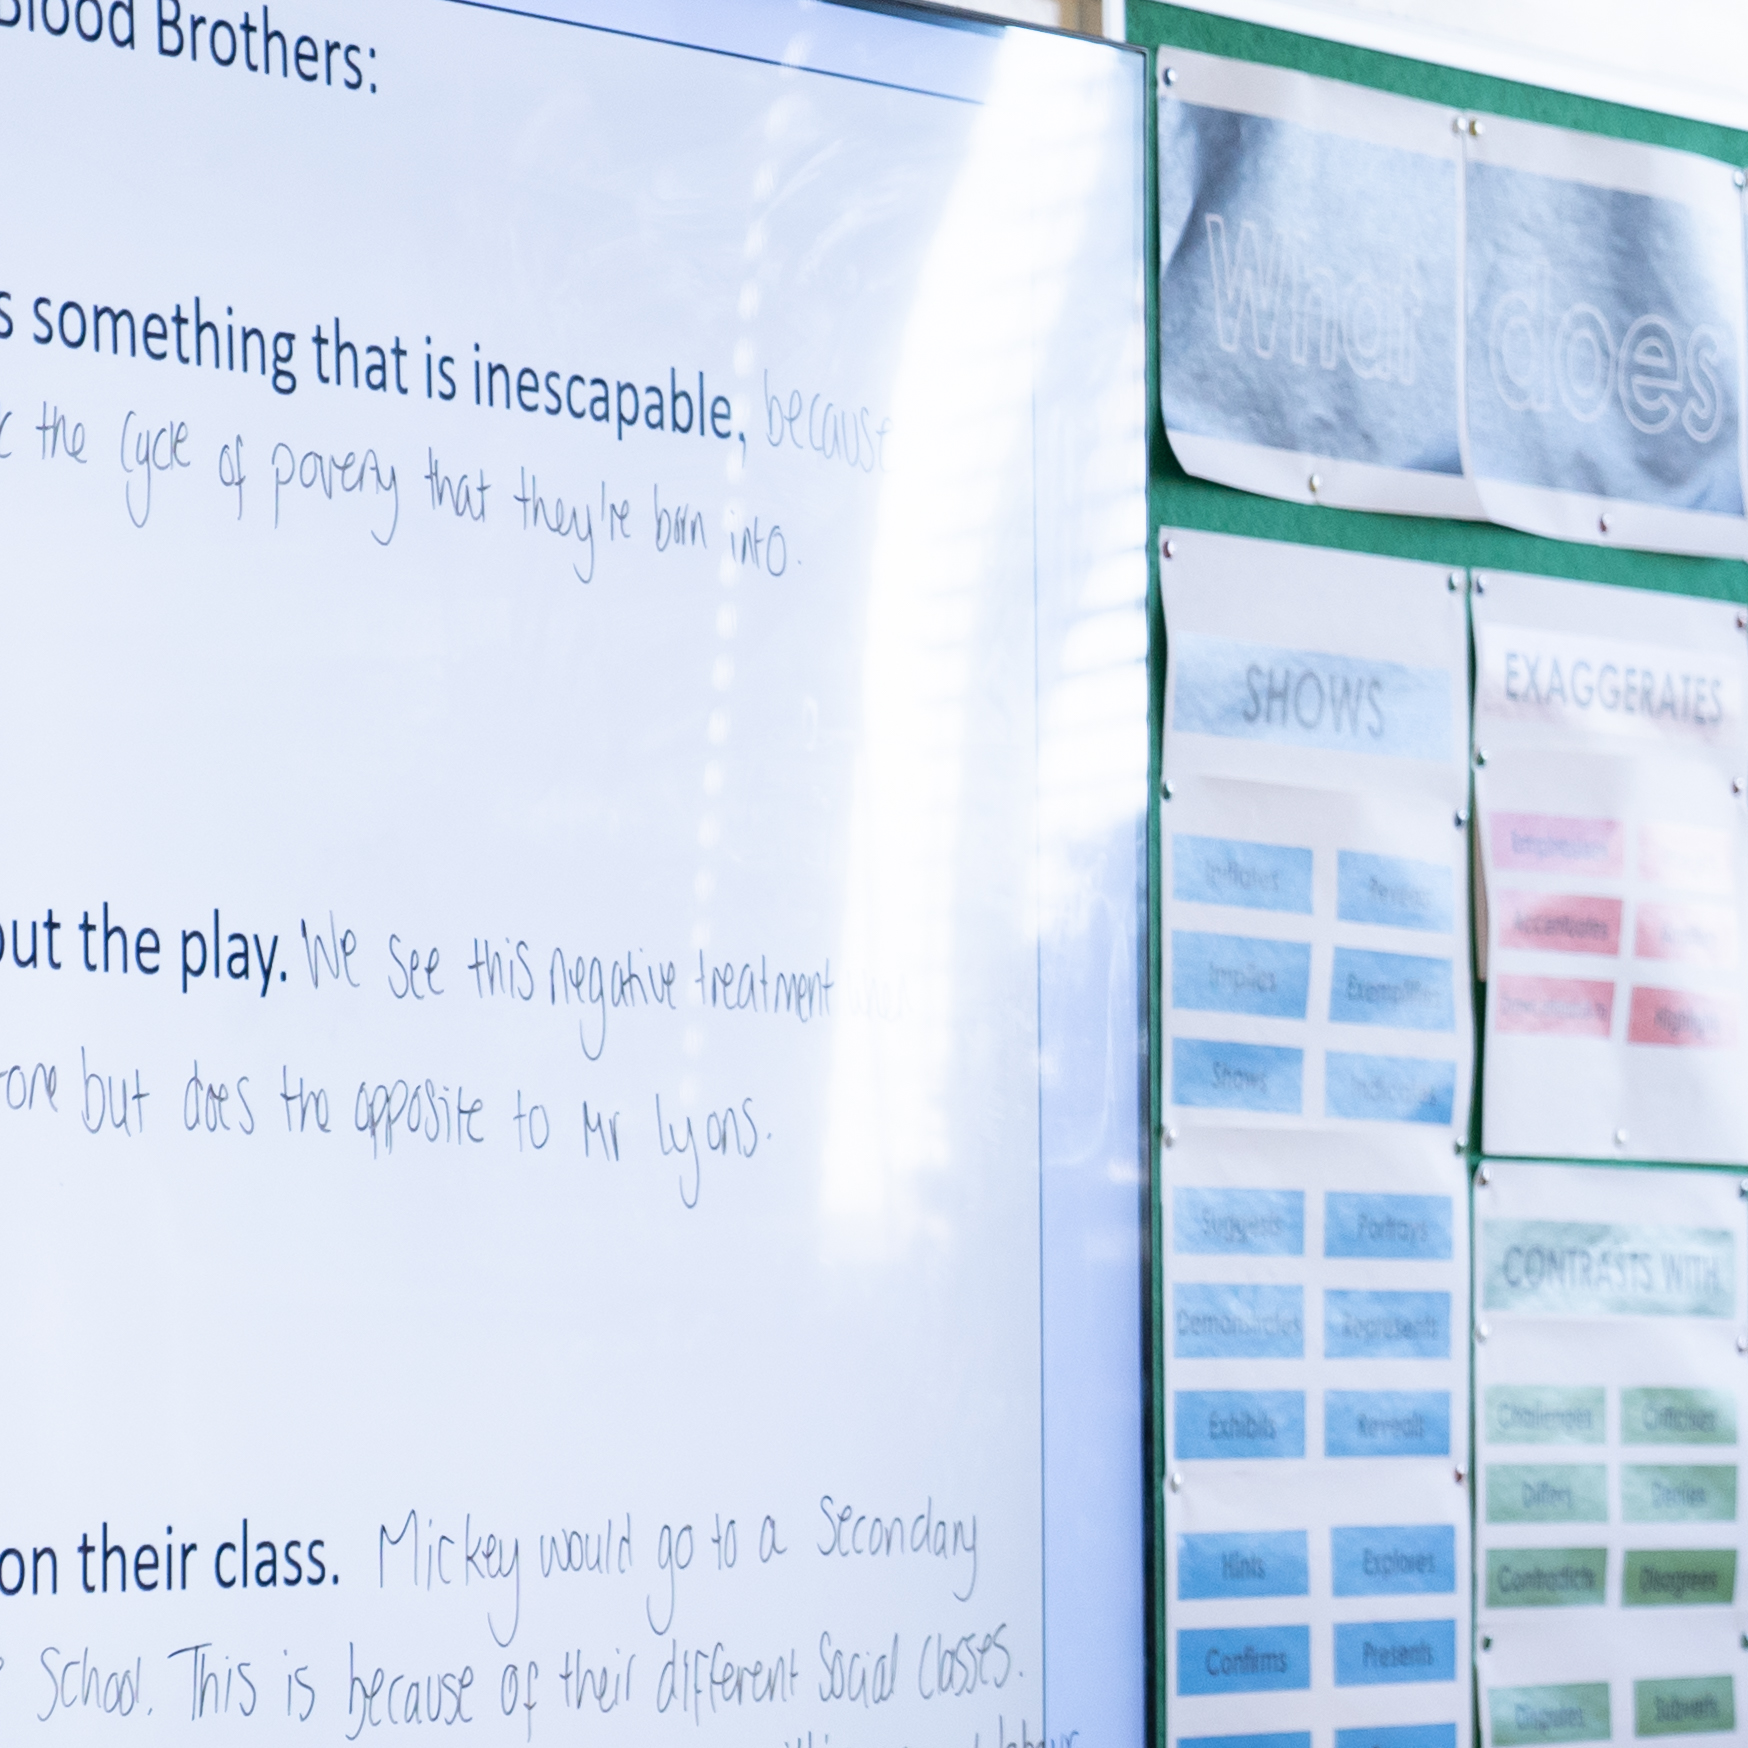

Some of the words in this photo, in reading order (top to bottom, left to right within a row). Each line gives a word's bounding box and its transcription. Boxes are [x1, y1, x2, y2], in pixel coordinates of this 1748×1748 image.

[156, 0, 377, 94] Brothers:
[32, 295, 297, 395] something
[312, 316, 408, 395] that
[425, 335, 457, 402] is
[474, 341, 747, 464] inescapable,
[1489, 257, 1726, 445] does
[36, 400, 88, 464] the
[219, 433, 247, 521] of
[424, 446, 492, 523] that
[513, 465, 632, 585] they're
[653, 483, 708, 552] born
[1242, 663, 1385, 738] SHOWS
[1505, 651, 1723, 726] EXAGGERATES
[0, 907, 62, 971] ut
[78, 900, 161, 975] the
[181, 907, 288, 998] play.
[301, 909, 361, 989] We
[468, 936, 535, 1002] this
[549, 946, 677, 1062] negative
[694, 947, 836, 1024] treatment
[0, 1061, 58, 1113] one
[81, 1045, 150, 1138] but
[183, 1058, 255, 1135] does
[279, 1064, 332, 1134] the
[354, 1077, 485, 1160] opposite
[512, 1089, 550, 1153] to
[1502, 1242, 1651, 1291] CONTRASTS
[0, 1540, 58, 1597] on
[77, 1521, 198, 1593] their
[214, 1517, 340, 1589] class.
[379, 1508, 520, 1648] Mickey
[541, 1512, 632, 1578] would
[645, 1524, 694, 1636] go
[711, 1512, 737, 1571] to
[759, 1514, 788, 1563] a
[167, 1642, 257, 1722] This
[282, 1648, 316, 1723] is
[345, 1641, 475, 1742] because
[499, 1660, 539, 1744] of
[558, 1647, 637, 1714] their
[657, 1638, 799, 1728] different
